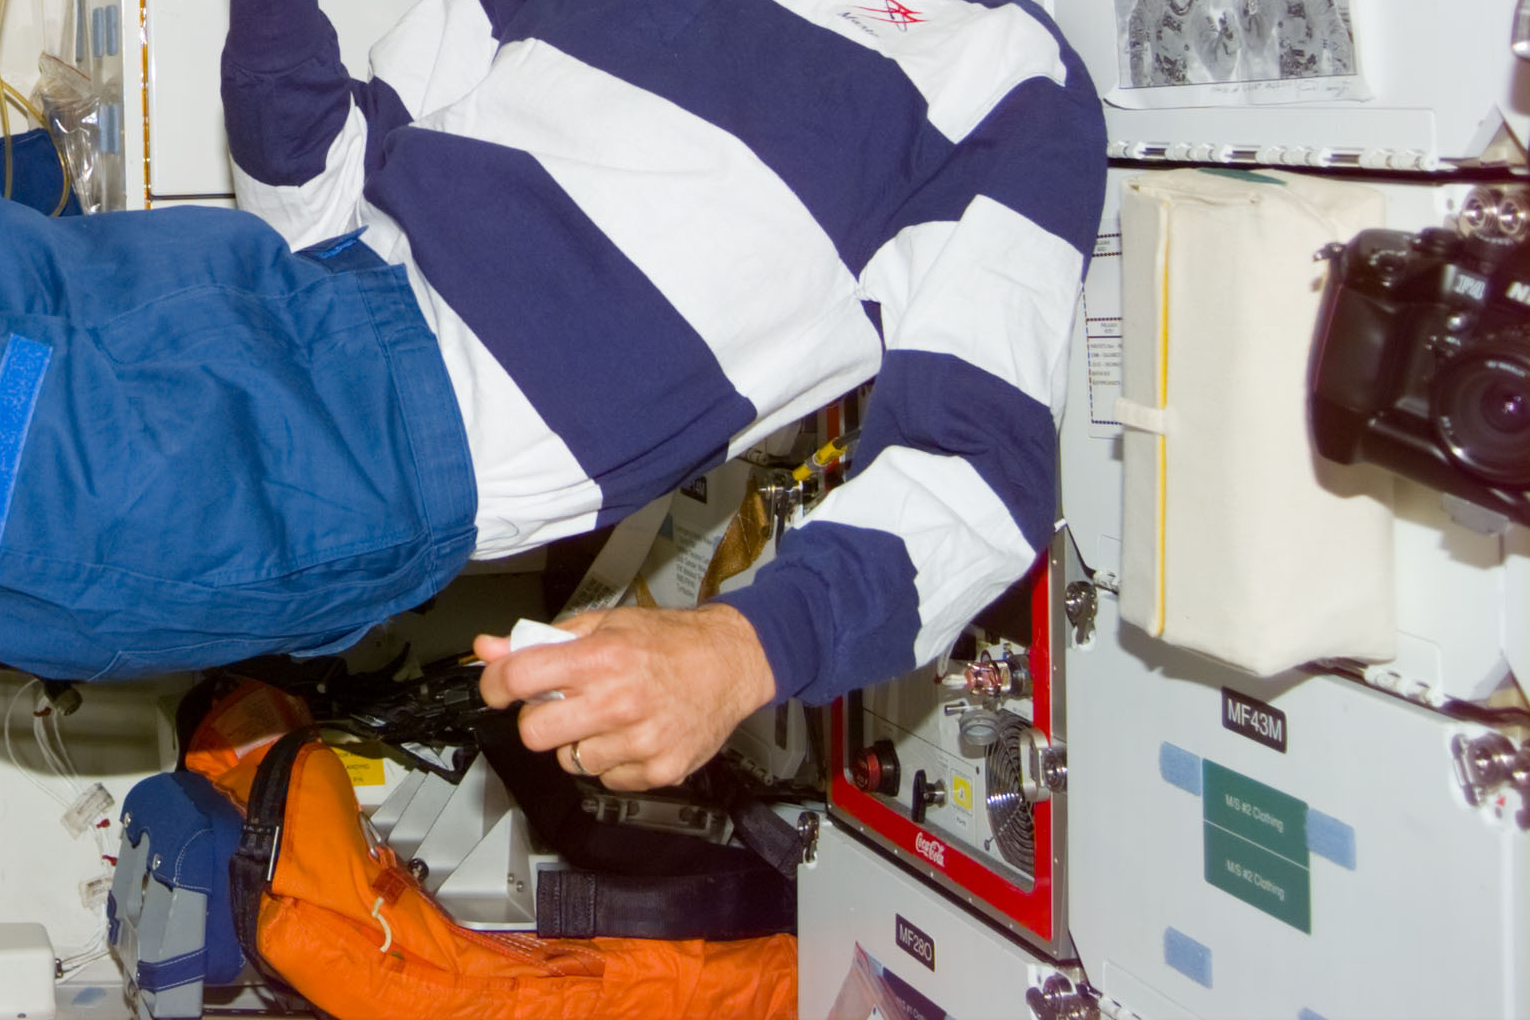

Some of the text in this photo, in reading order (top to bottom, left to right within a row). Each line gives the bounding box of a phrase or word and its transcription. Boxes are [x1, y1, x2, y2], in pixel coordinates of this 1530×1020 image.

[1227, 698, 1283, 742] MF43M
[1225, 793, 1284, 834] M/S #2 Clothing
[1242, 866, 1253, 884] #2
[1253, 873, 1285, 901] Clothing
